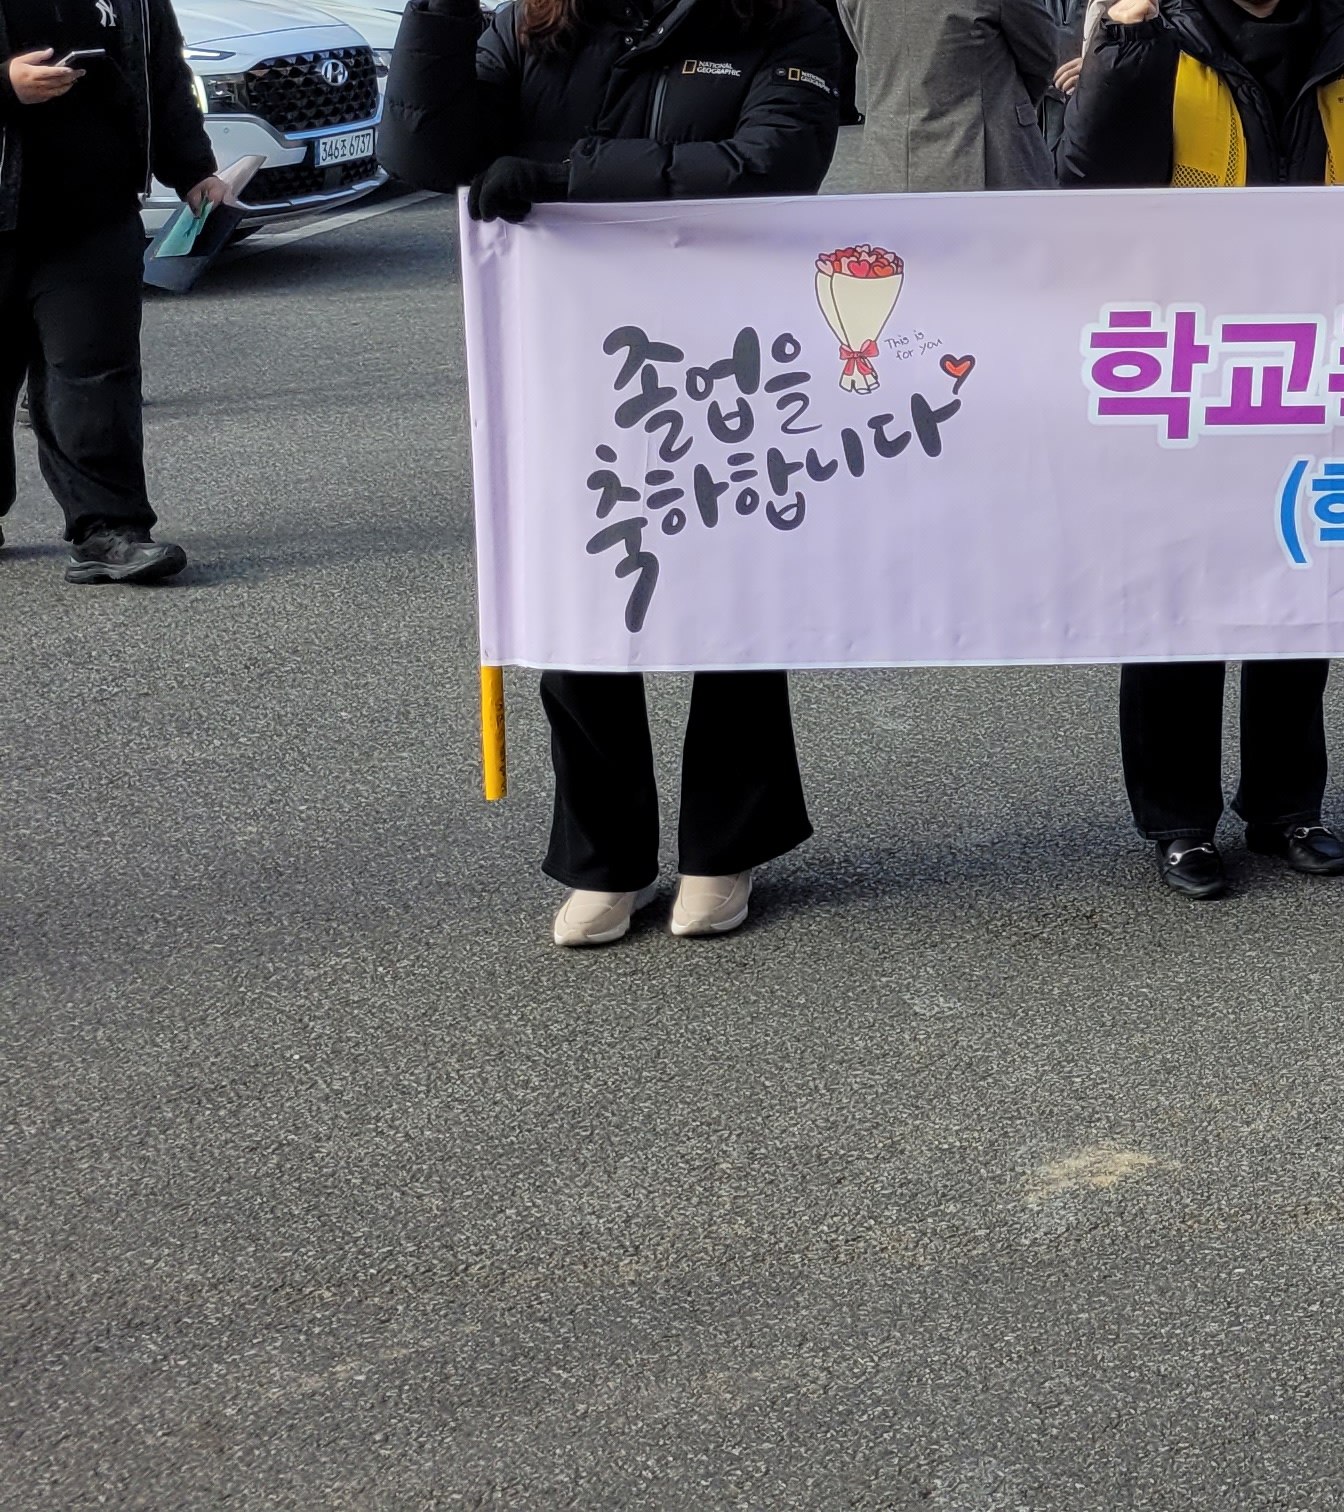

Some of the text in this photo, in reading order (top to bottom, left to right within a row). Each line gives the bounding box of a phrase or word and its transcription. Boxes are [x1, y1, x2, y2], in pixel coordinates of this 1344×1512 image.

[321, 133, 372, 162] 346조 6737
[884, 330, 925, 350] This is
[896, 338, 943, 361] for you
[602, 325, 823, 463] 졸업을
[585, 392, 962, 634] 축하합니다
